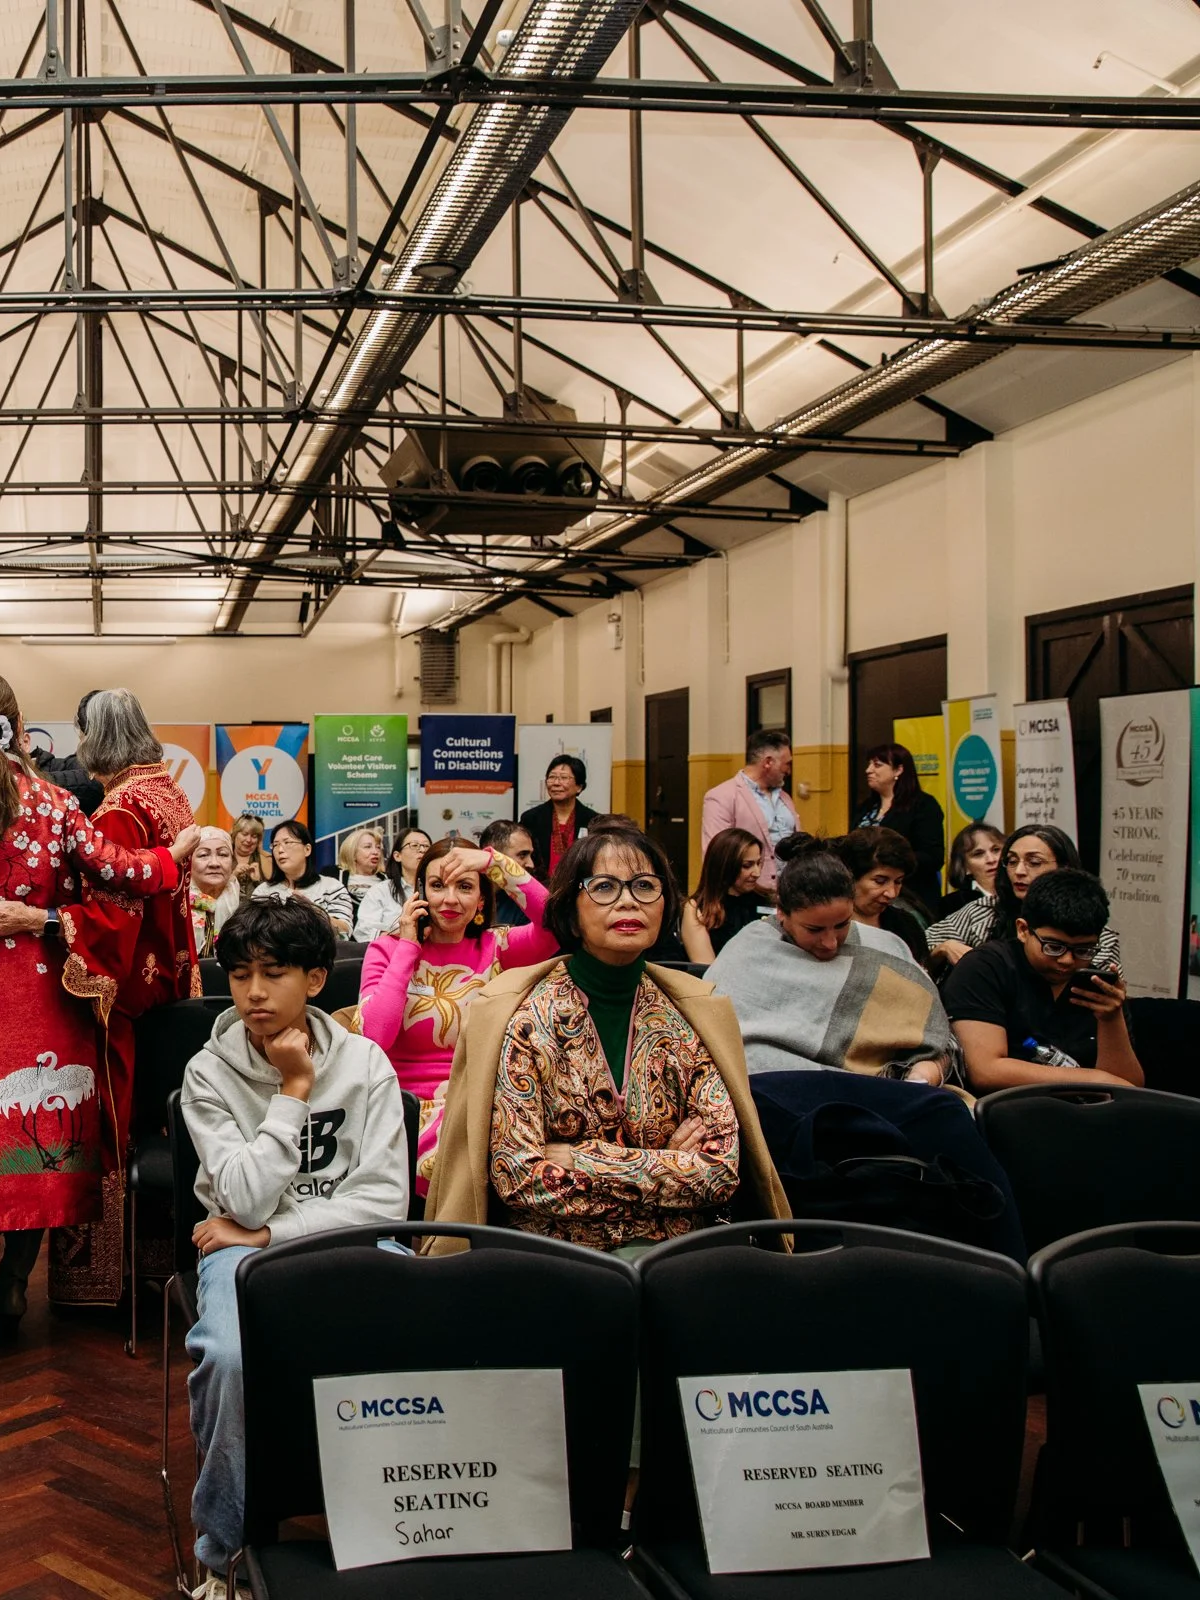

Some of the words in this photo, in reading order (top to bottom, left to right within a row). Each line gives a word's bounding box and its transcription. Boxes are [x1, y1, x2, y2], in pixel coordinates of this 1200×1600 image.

[1029, 718, 1060, 733] MCCSA
[445, 737, 491, 747] Cultural
[432, 748, 504, 759] Connections
[1130, 740, 1151, 760] 45
[341, 754, 363, 762] Aged
[363, 754, 383, 762] Care
[327, 762, 365, 770] Volunteer
[366, 762, 397, 770] Visitors
[434, 760, 446, 770] in
[448, 760, 502, 772] Disability
[250, 758, 273, 791] Y
[346, 771, 378, 779] Scheme
[245, 793, 279, 801] MCCSA
[246, 801, 279, 809] YOUTH
[241, 809, 284, 817] COUNCIL
[1112, 806, 1126, 820] 45
[1128, 806, 1164, 820] YEARS
[1113, 826, 1161, 840] STRONG.
[1108, 848, 1164, 867] Celebrating
[1116, 868, 1129, 881] 70
[1129, 873, 1156, 885] years
[1106, 886, 1117, 900] of
[1119, 888, 1162, 903] tradition.
[361, 1396, 445, 1418] MCCSA
[727, 1389, 830, 1418] MCCSA
[700, 1427, 734, 1435] Multicultural
[734, 1425, 770, 1434] Communities
[770, 1424, 789, 1433] Council
[789, 1424, 795, 1432] of
[796, 1424, 812, 1432] South
[812, 1423, 834, 1431] Australia
[382, 1461, 498, 1484] RESERVED
[743, 1465, 817, 1482] RESERVED
[826, 1462, 883, 1478] SEATING
[394, 1491, 490, 1513] SEATING
[775, 1502, 802, 1511] MCCSA
[805, 1500, 831, 1510] BOARD
[831, 1498, 864, 1508] MEMBER
[395, 1520, 455, 1546] Sahar
[790, 1531, 805, 1540] MR.
[806, 1529, 831, 1539] SUREN
[831, 1527, 857, 1537] EDGAR
